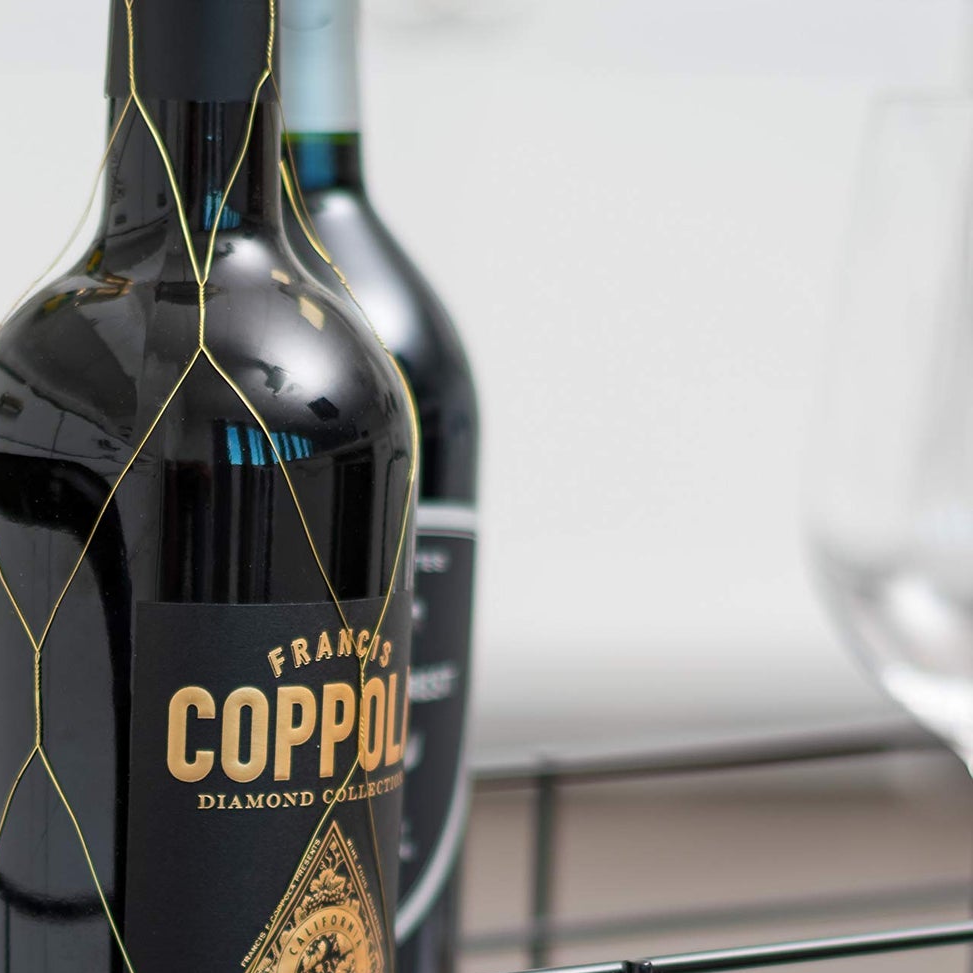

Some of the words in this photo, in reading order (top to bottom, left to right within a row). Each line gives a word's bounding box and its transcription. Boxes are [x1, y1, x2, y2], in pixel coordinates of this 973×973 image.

[267, 628, 393, 679] FRANCIS
[167, 665, 410, 784] COPPOL
[197, 791, 314, 810] DIAMOND
[240, 931, 267, 968] FRANCIS
[295, 838, 321, 881] PRESENTS
[289, 914, 362, 955] CALIFORNIA
